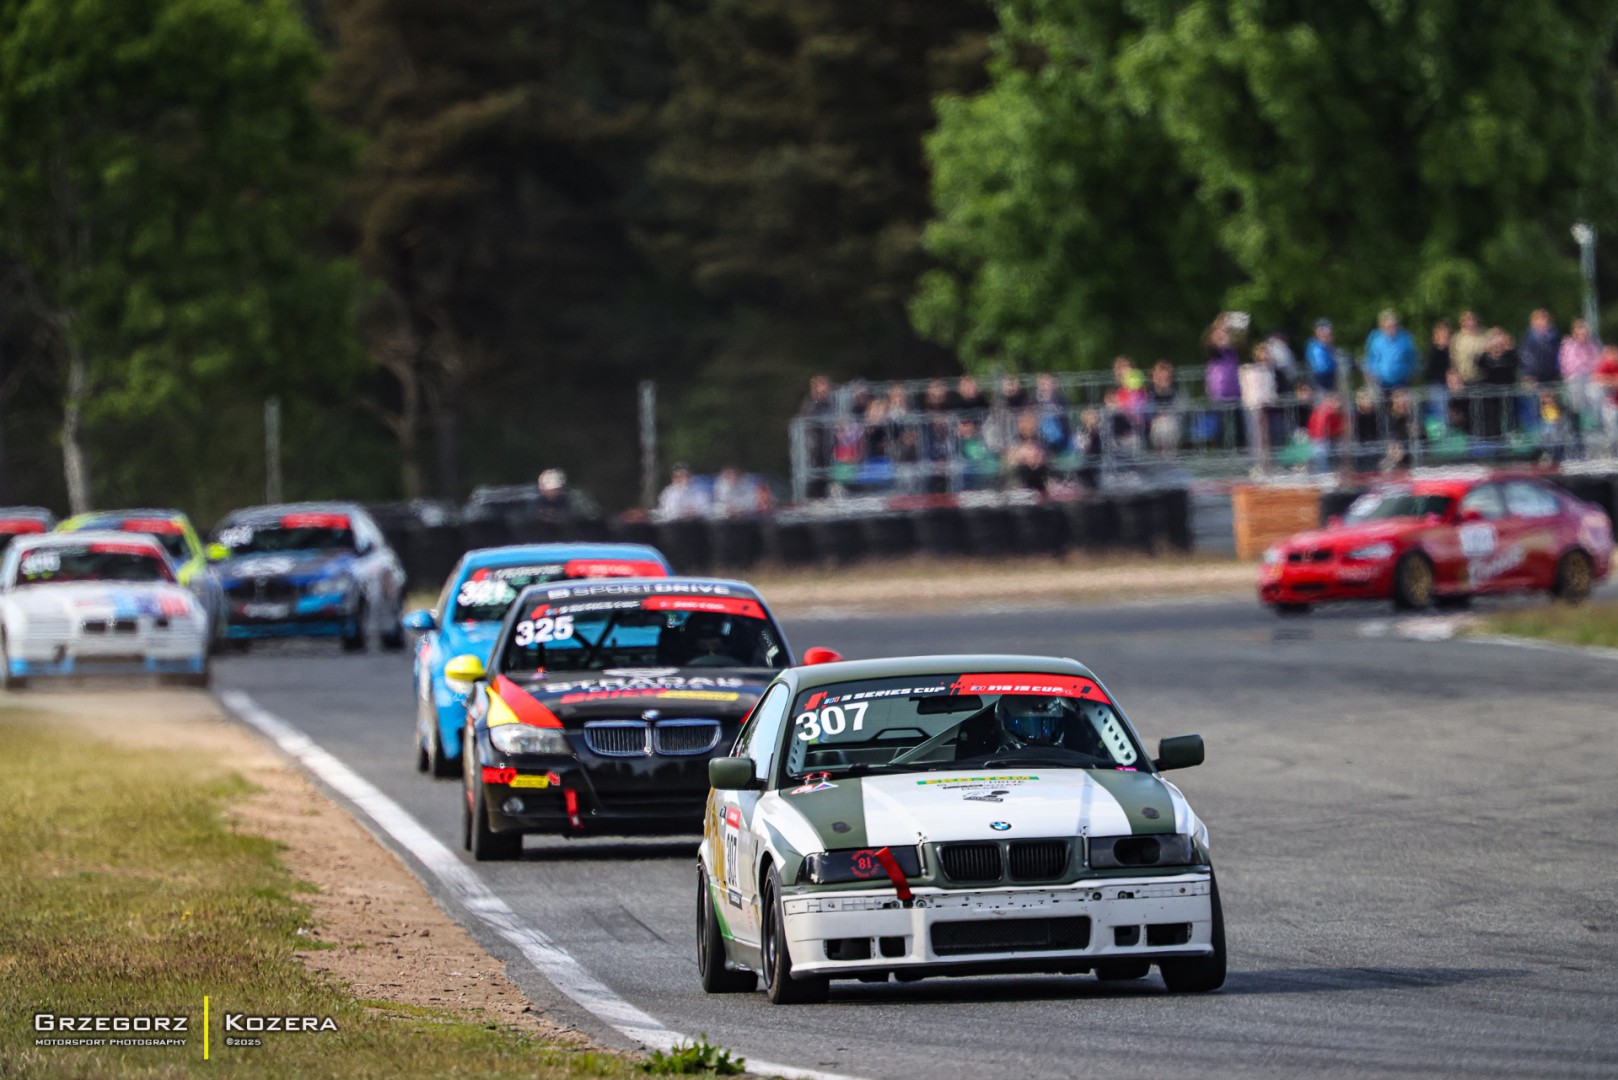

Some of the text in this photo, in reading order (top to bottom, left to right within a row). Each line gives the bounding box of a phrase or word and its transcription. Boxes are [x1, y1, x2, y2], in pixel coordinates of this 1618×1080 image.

[573, 584, 731, 596] SPORTDRIVE
[515, 615, 574, 646] 325
[853, 688, 912, 699] SERIES
[913, 686, 946, 694] CUP
[795, 701, 869, 741] 307
[726, 833, 738, 887] 307
[858, 856, 872, 869] 81
